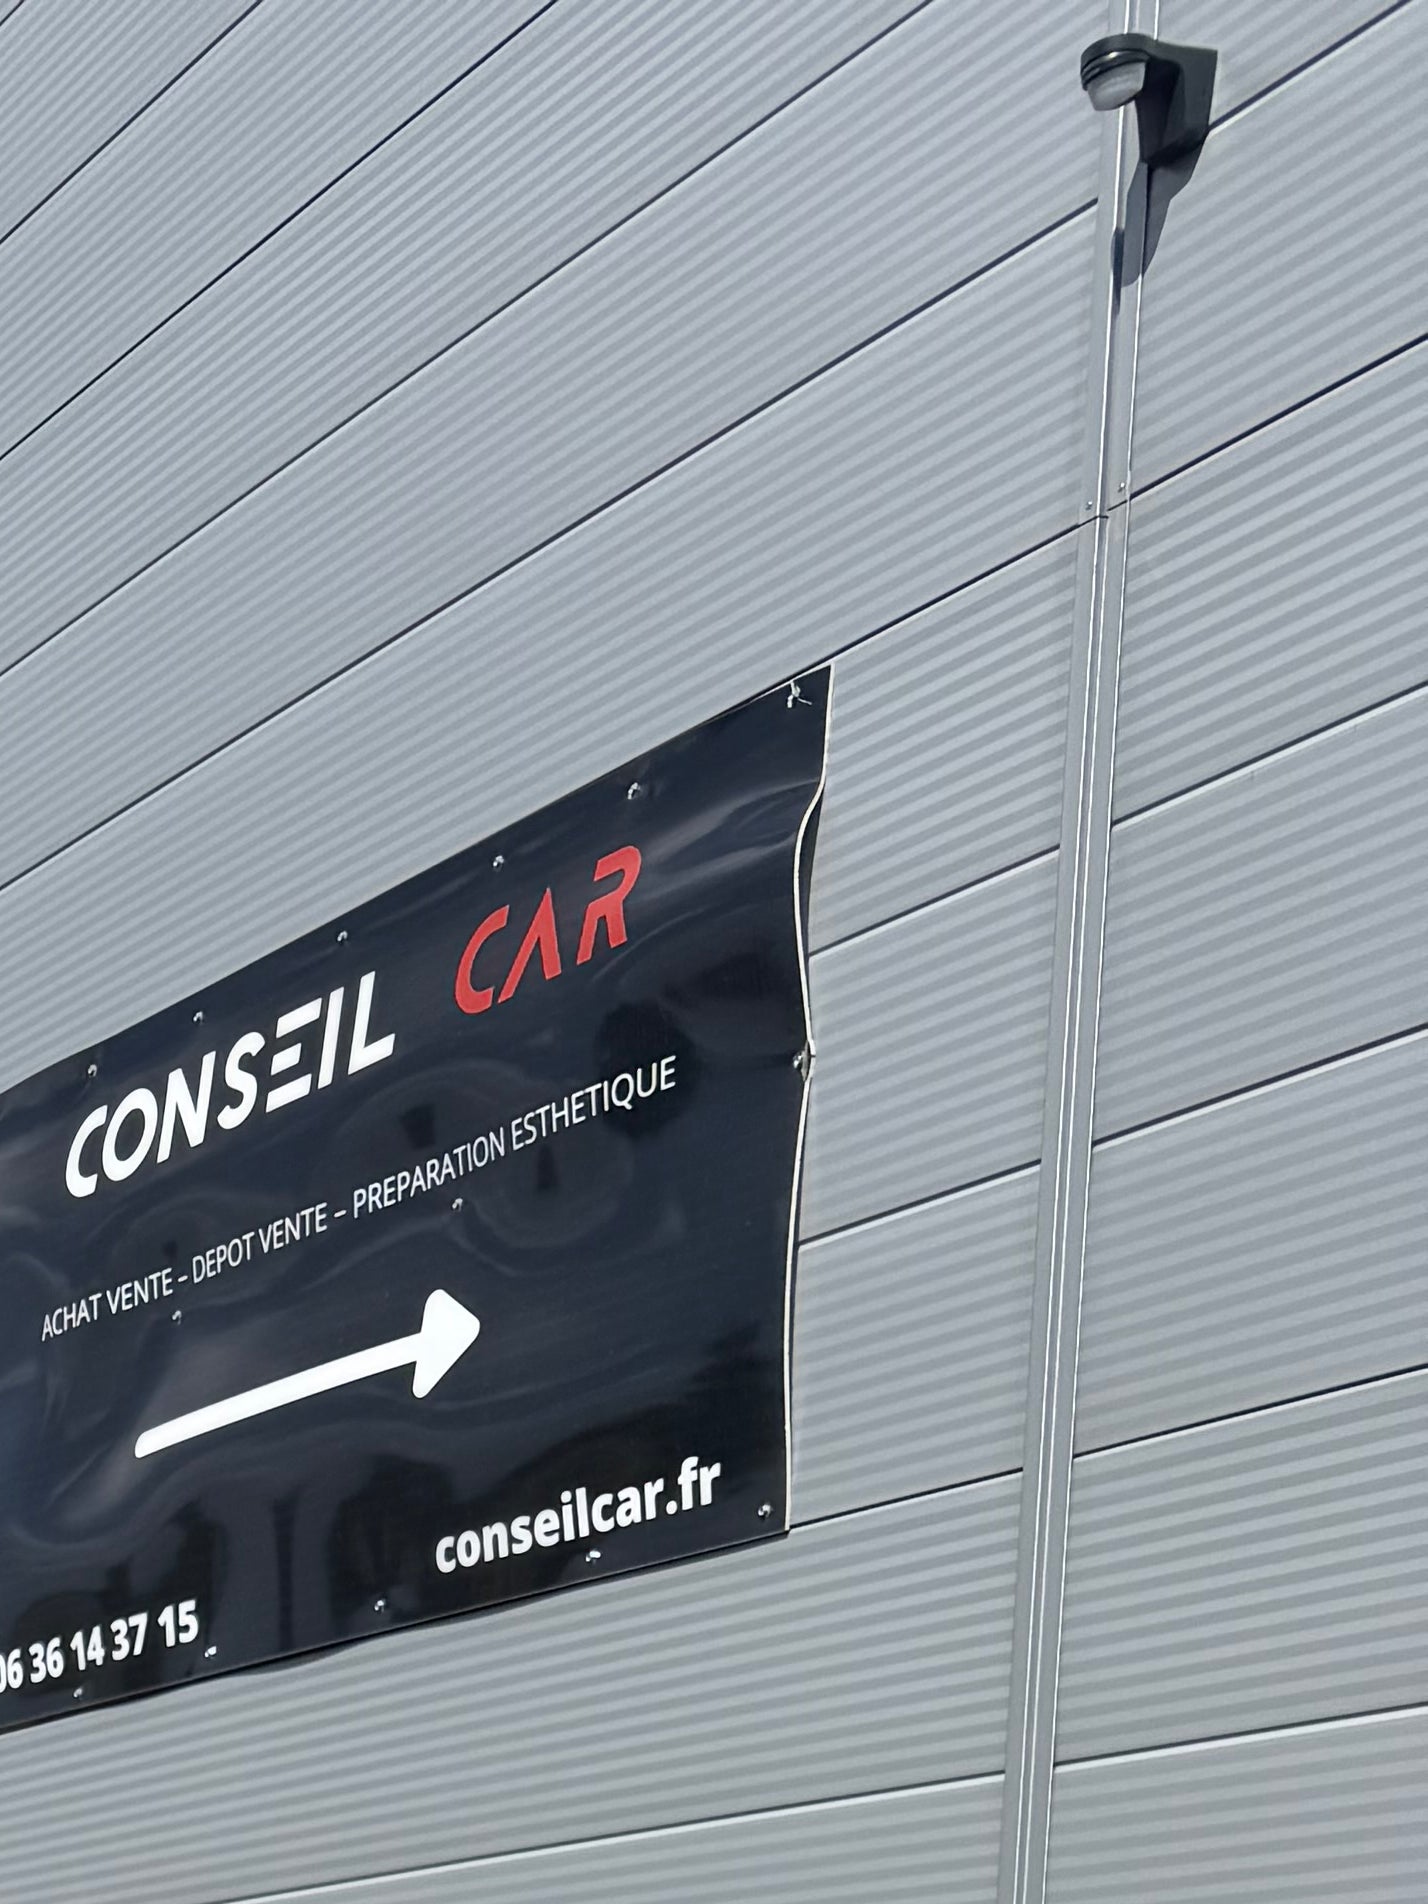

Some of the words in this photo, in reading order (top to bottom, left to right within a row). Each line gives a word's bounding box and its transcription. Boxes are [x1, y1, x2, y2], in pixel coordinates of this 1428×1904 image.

[65, 970, 396, 1198] CONSEIL
[453, 844, 642, 1015] CAR
[40, 1292, 103, 1342] ACHAT
[105, 1267, 174, 1315] VENTE
[192, 1231, 256, 1284] DEPOT
[258, 1201, 329, 1254] VENTE
[353, 1126, 505, 1219] PREPARATION
[511, 1055, 677, 1151] ESTHETIQUE
[433, 1454, 722, 1575] conseilcar.fr
[28, 1636, 65, 1684] 36
[70, 1624, 106, 1671] 14
[110, 1612, 149, 1662] 37
[156, 1599, 199, 1648] 15
